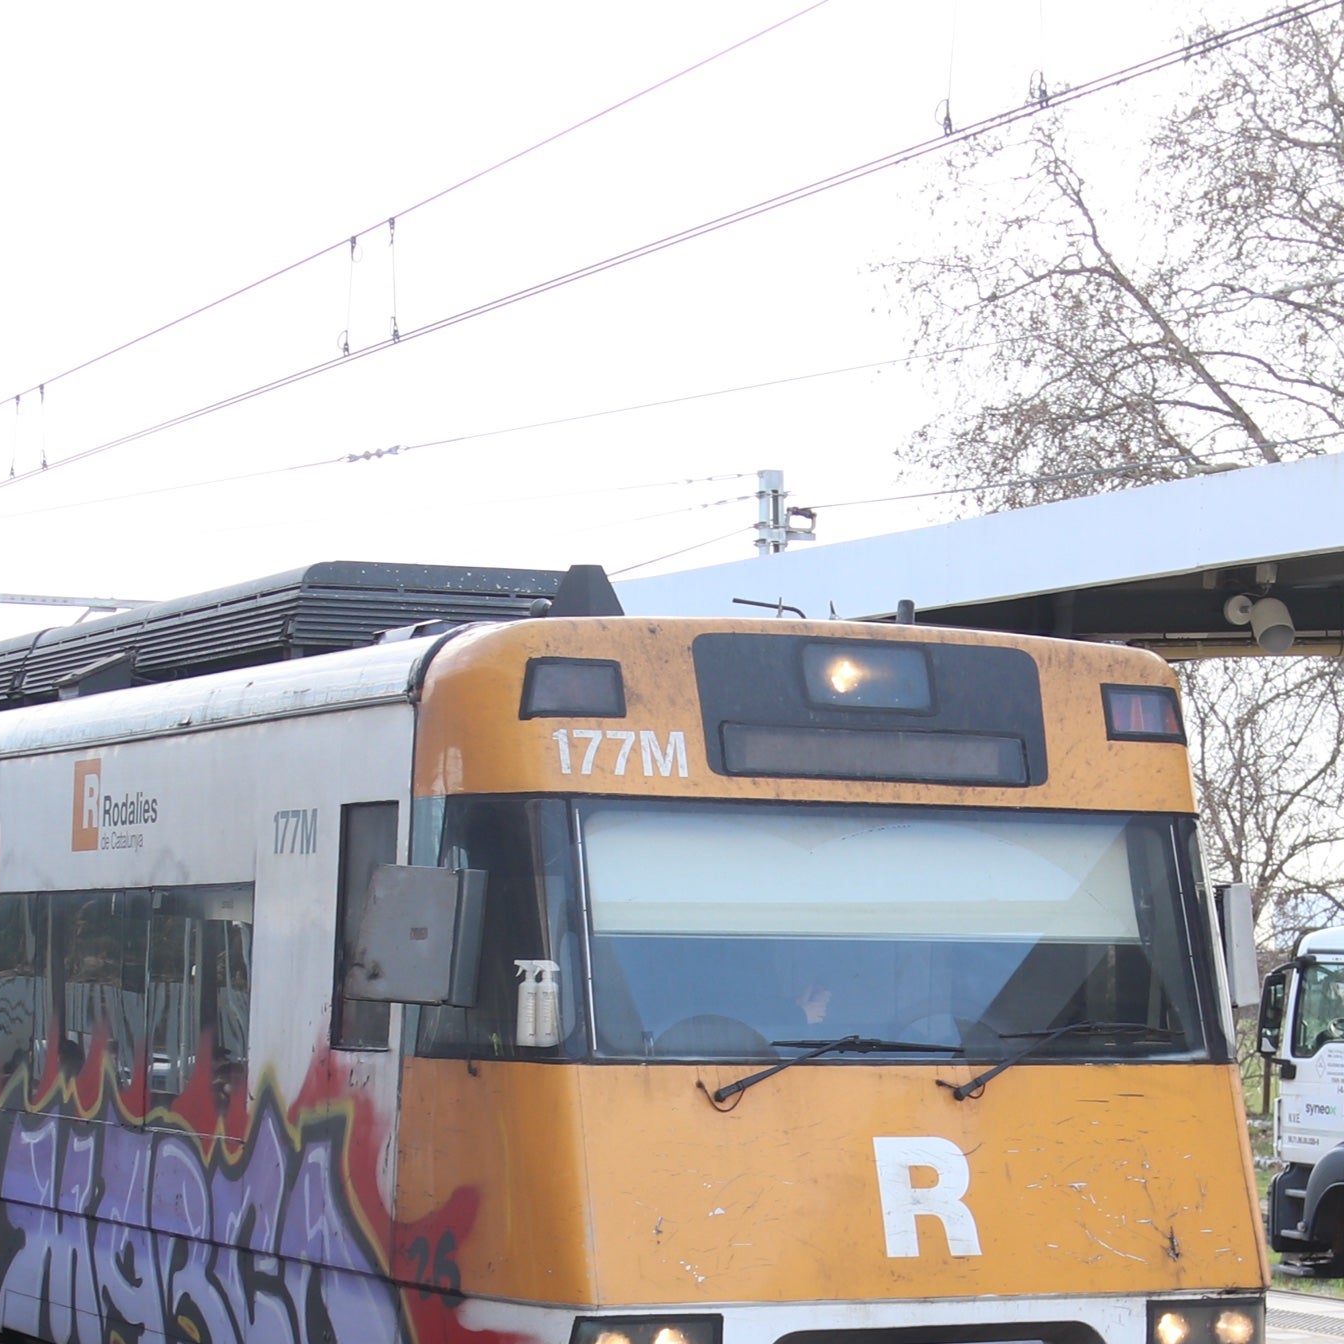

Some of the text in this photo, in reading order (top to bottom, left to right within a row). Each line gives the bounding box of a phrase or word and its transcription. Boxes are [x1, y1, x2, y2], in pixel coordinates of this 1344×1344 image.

[552, 729, 689, 778] 177M
[102, 791, 158, 827] Rodalies
[273, 807, 318, 855] 177M
[1305, 1102, 1336, 1117] syneox
[872, 1136, 983, 1258] R
